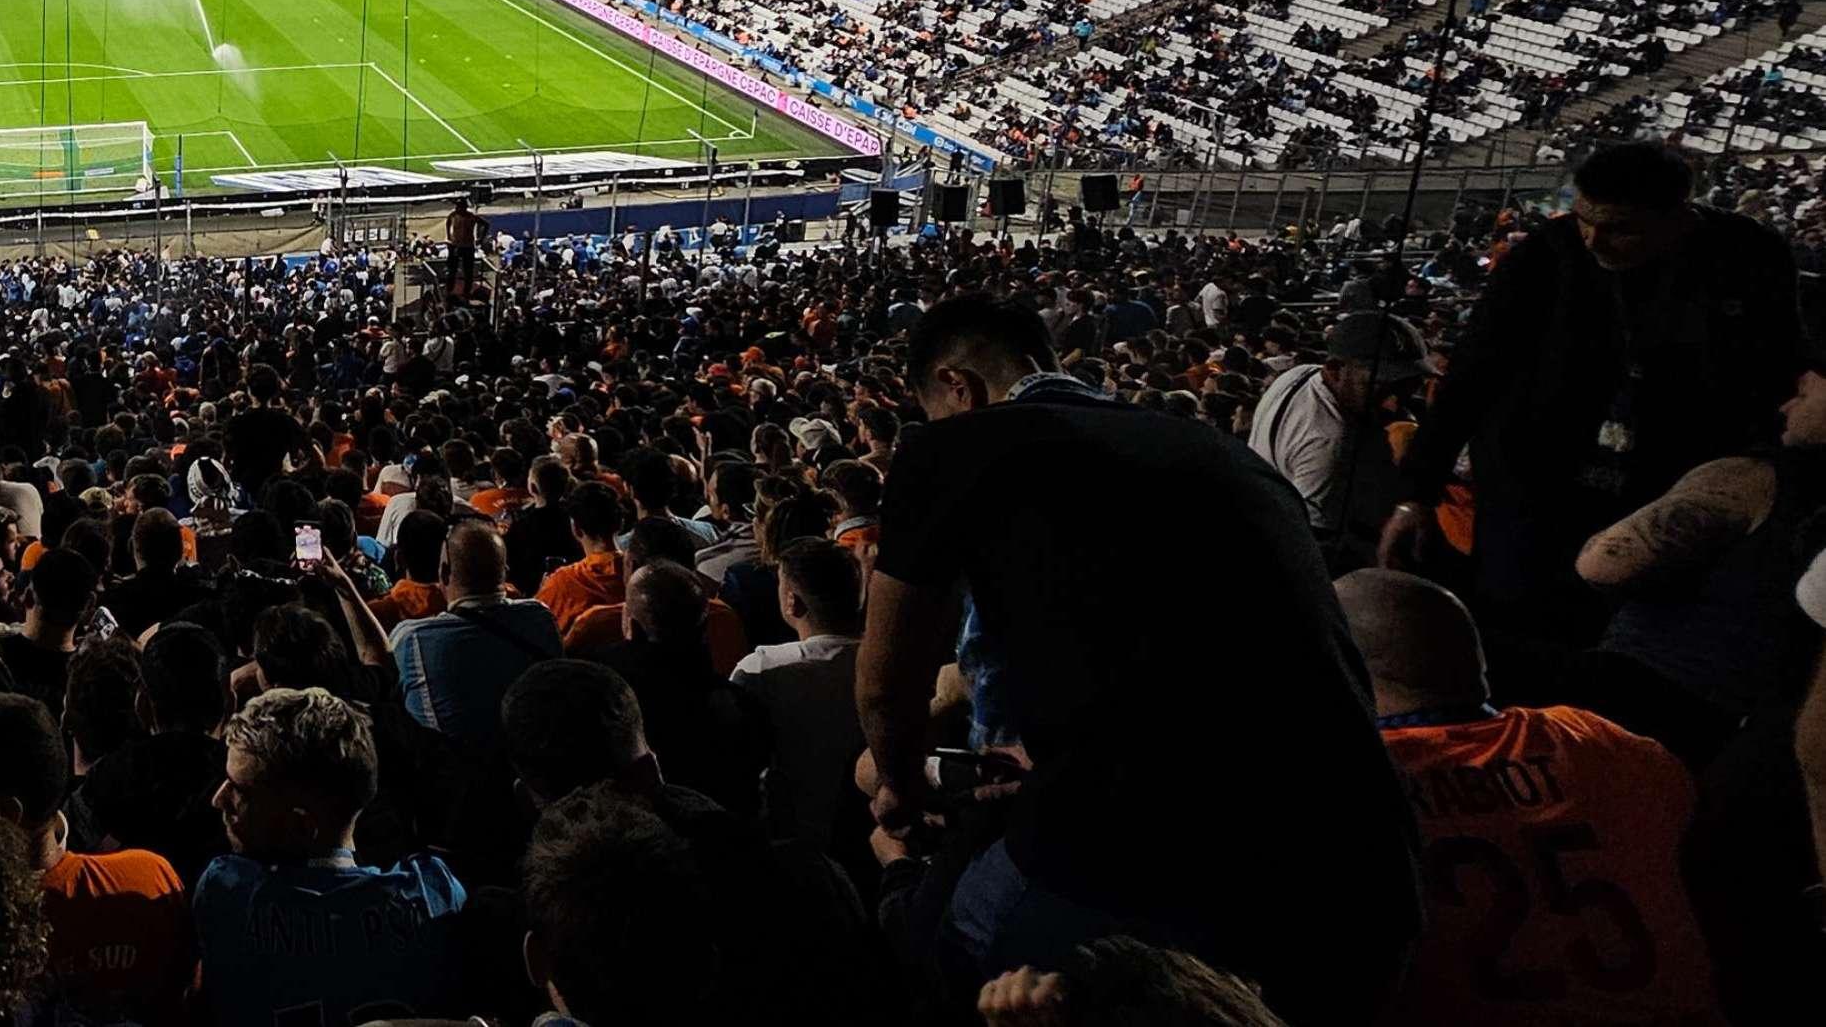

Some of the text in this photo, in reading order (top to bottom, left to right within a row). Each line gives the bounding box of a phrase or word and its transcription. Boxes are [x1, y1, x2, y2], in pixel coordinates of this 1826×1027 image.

[651, 31, 683, 58] CAISSE
[684, 46, 740, 86] D'EPARGNE
[741, 74, 775, 104] CEPAC
[789, 99, 879, 156] CAISSE D'EPAR
[88, 944, 137, 972] SUD
